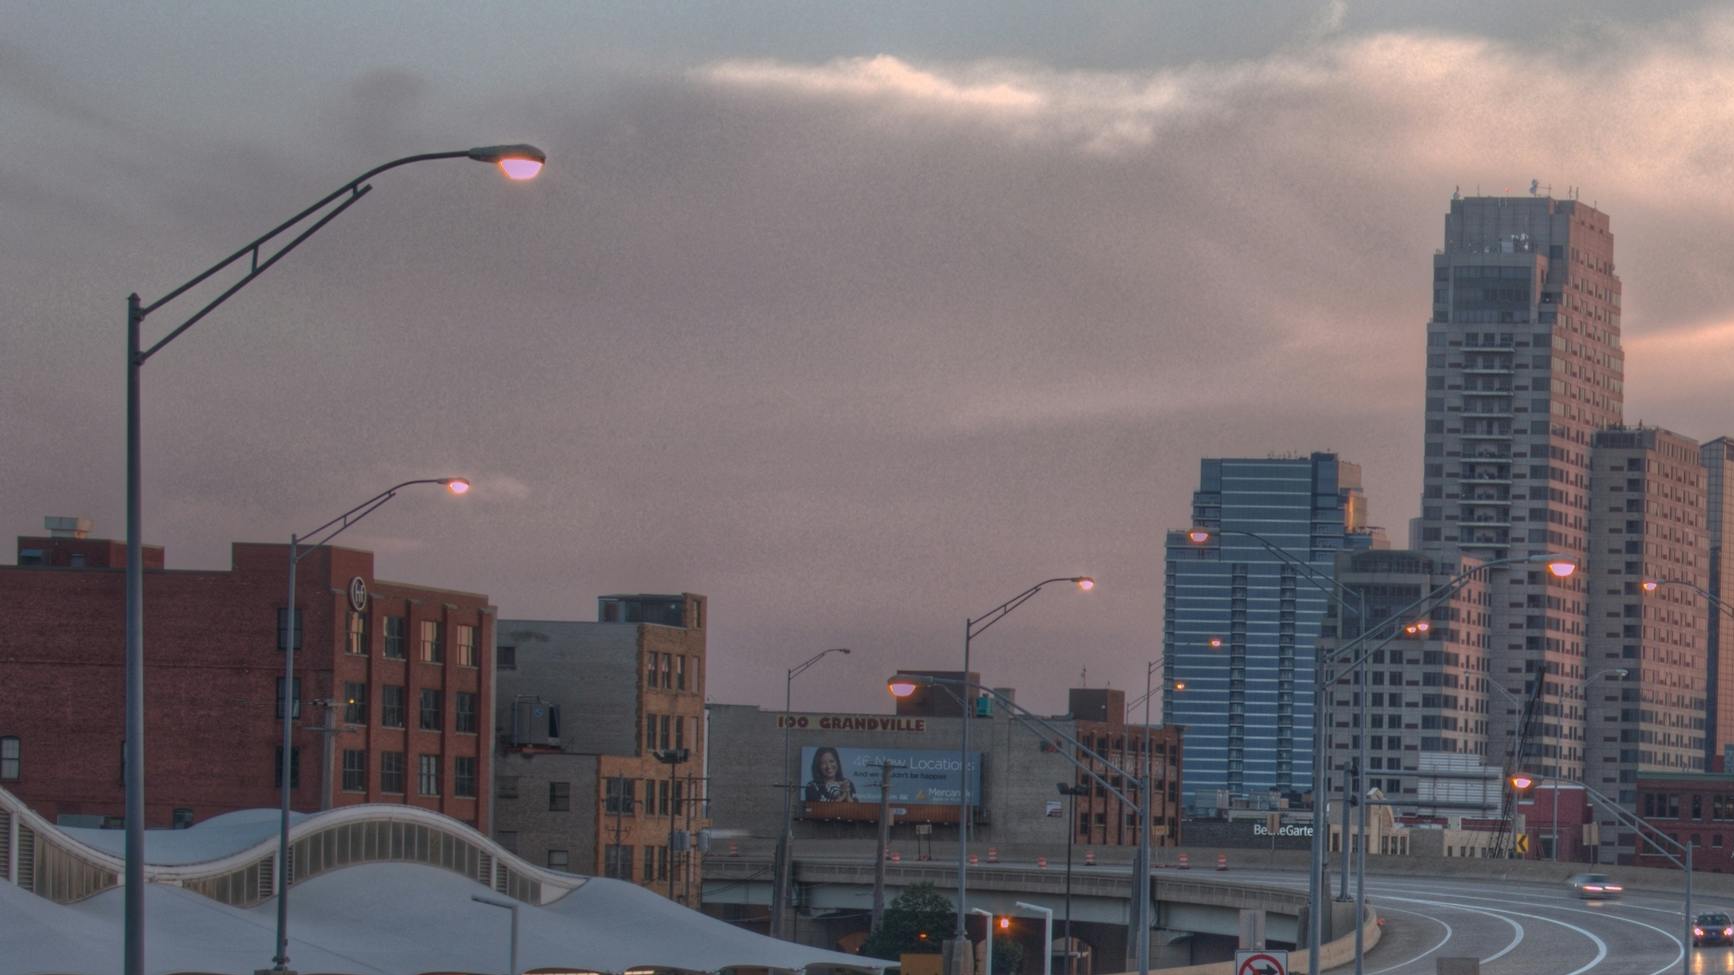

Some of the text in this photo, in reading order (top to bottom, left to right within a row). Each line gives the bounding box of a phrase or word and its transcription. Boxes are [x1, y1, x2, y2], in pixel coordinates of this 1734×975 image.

[777, 716, 926, 731] 100 GRANDVILLE
[910, 757, 975, 771] Locatios
